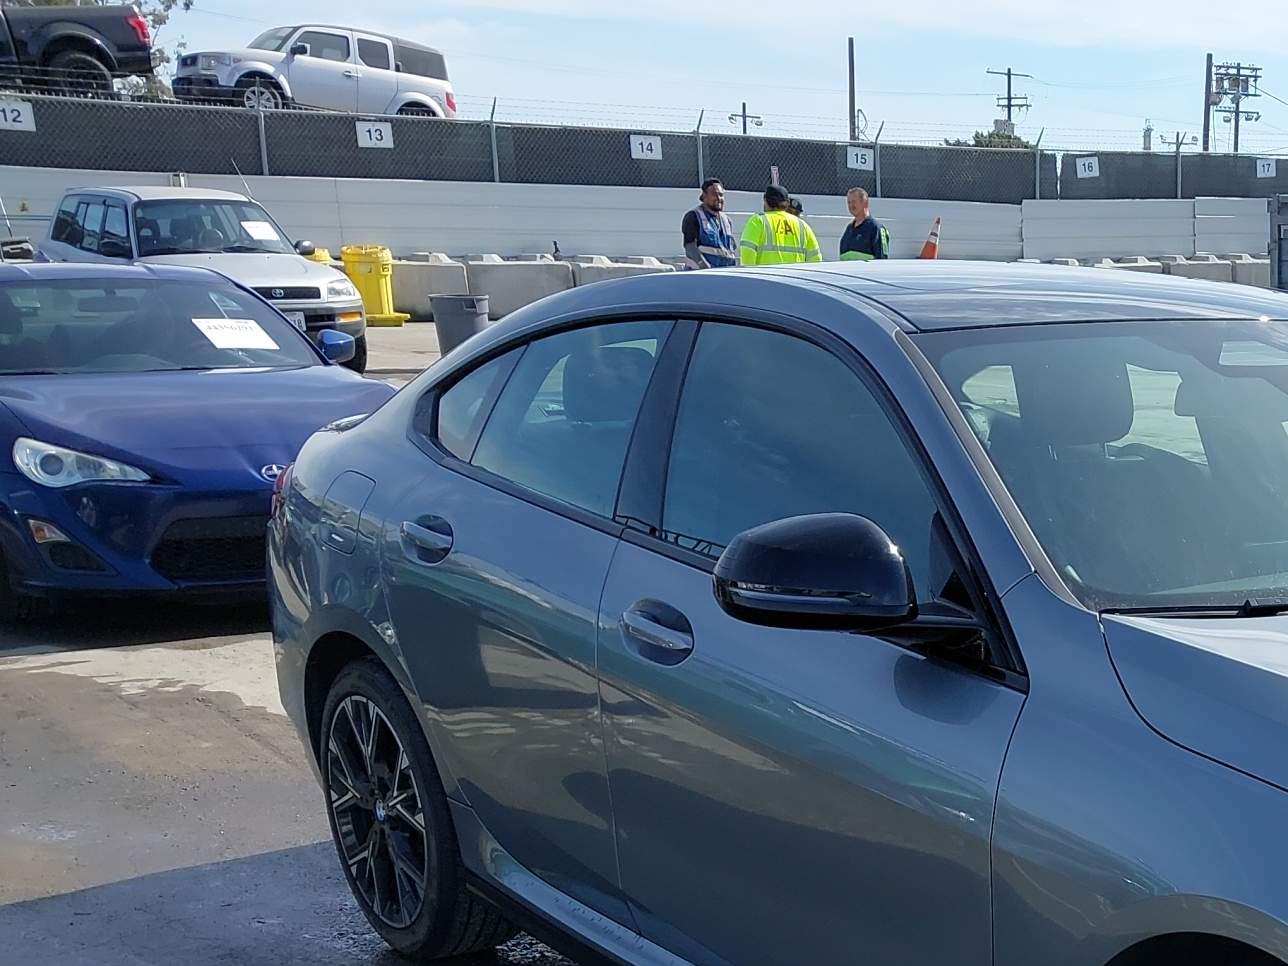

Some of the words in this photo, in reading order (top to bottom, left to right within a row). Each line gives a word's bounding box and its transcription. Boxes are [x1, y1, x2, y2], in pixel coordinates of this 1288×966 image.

[0, 108, 23, 123] 12
[365, 128, 384, 142] 13
[638, 141, 653, 154] 14
[854, 152, 867, 165] 15
[1081, 161, 1094, 173] 16
[1262, 163, 1271, 174] 17
